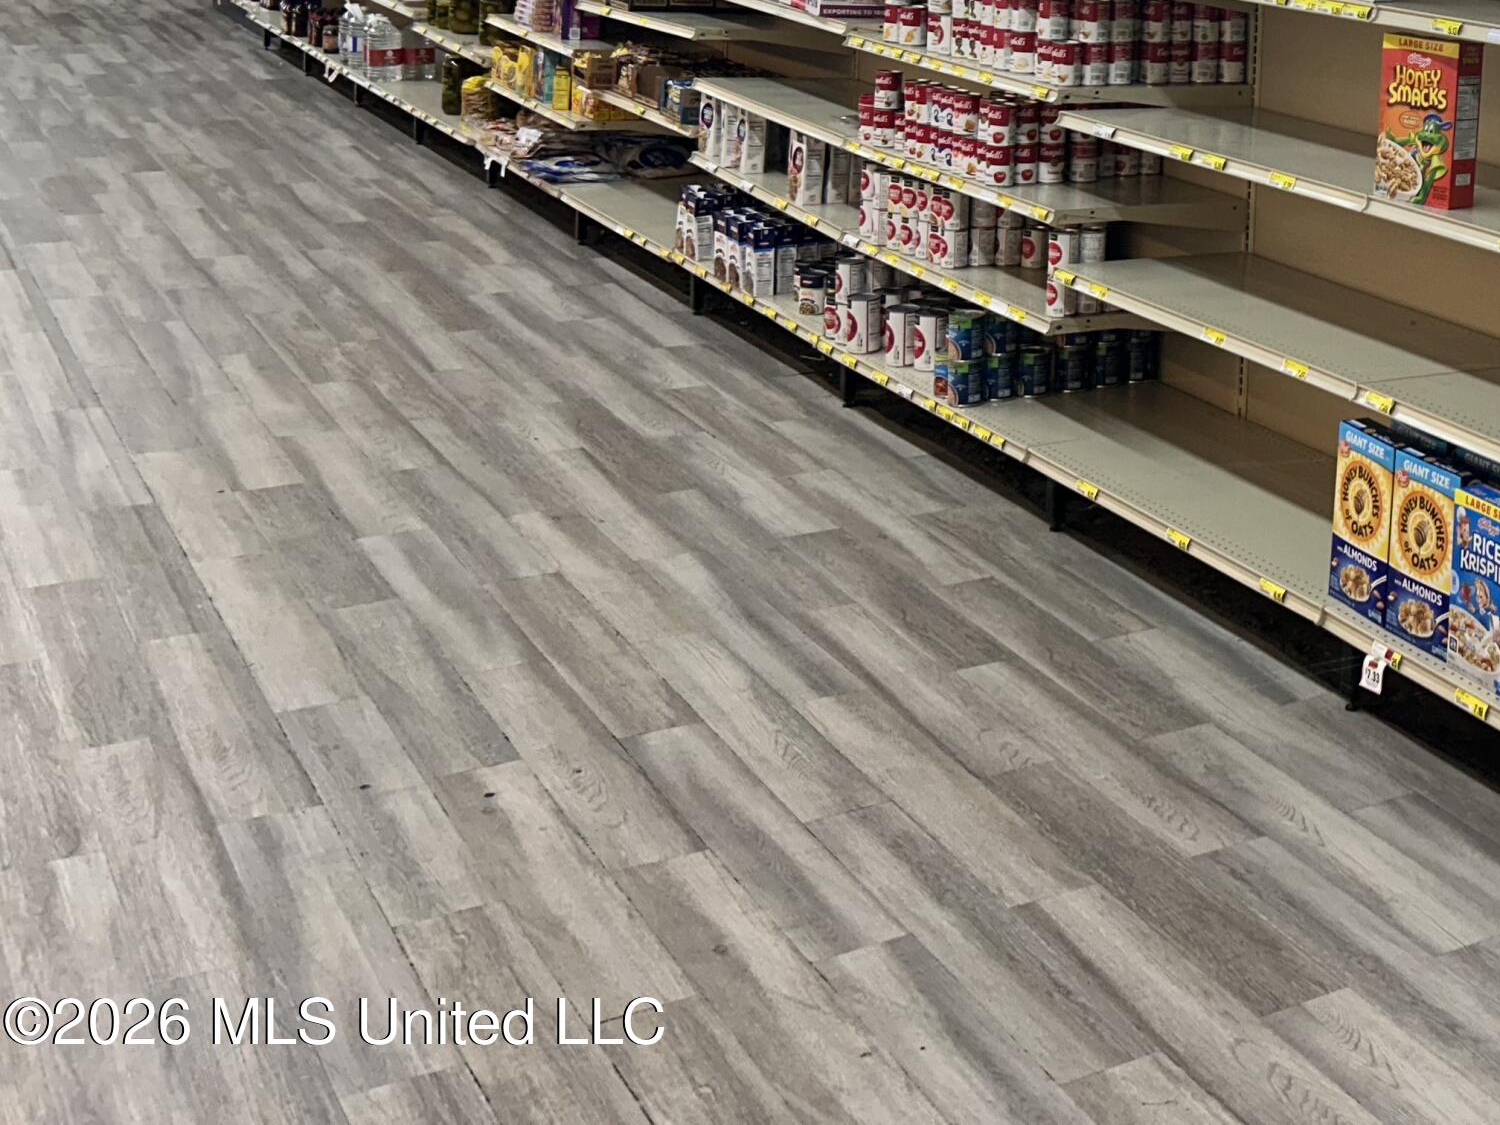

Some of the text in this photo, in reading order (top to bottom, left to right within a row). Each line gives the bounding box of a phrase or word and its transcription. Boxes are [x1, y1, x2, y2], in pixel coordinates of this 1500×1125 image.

[1399, 38, 1443, 53] LARGE SIZE
[1394, 64, 1442, 88] HONEY
[1388, 82, 1447, 111] SMACKS
[1345, 431, 1385, 460] GIANT SIZE
[1403, 459, 1451, 490] GIANT SIZE
[1342, 464, 1380, 520] HONEY BUNCHES
[1464, 495, 1491, 516] LARGE
[1351, 520, 1374, 539] OATS
[1400, 495, 1445, 552] HONEY BUNCHES
[1343, 544, 1377, 572] ALMONDS
[1411, 552, 1438, 572] OATS
[1402, 577, 1443, 606] ALMONDS
